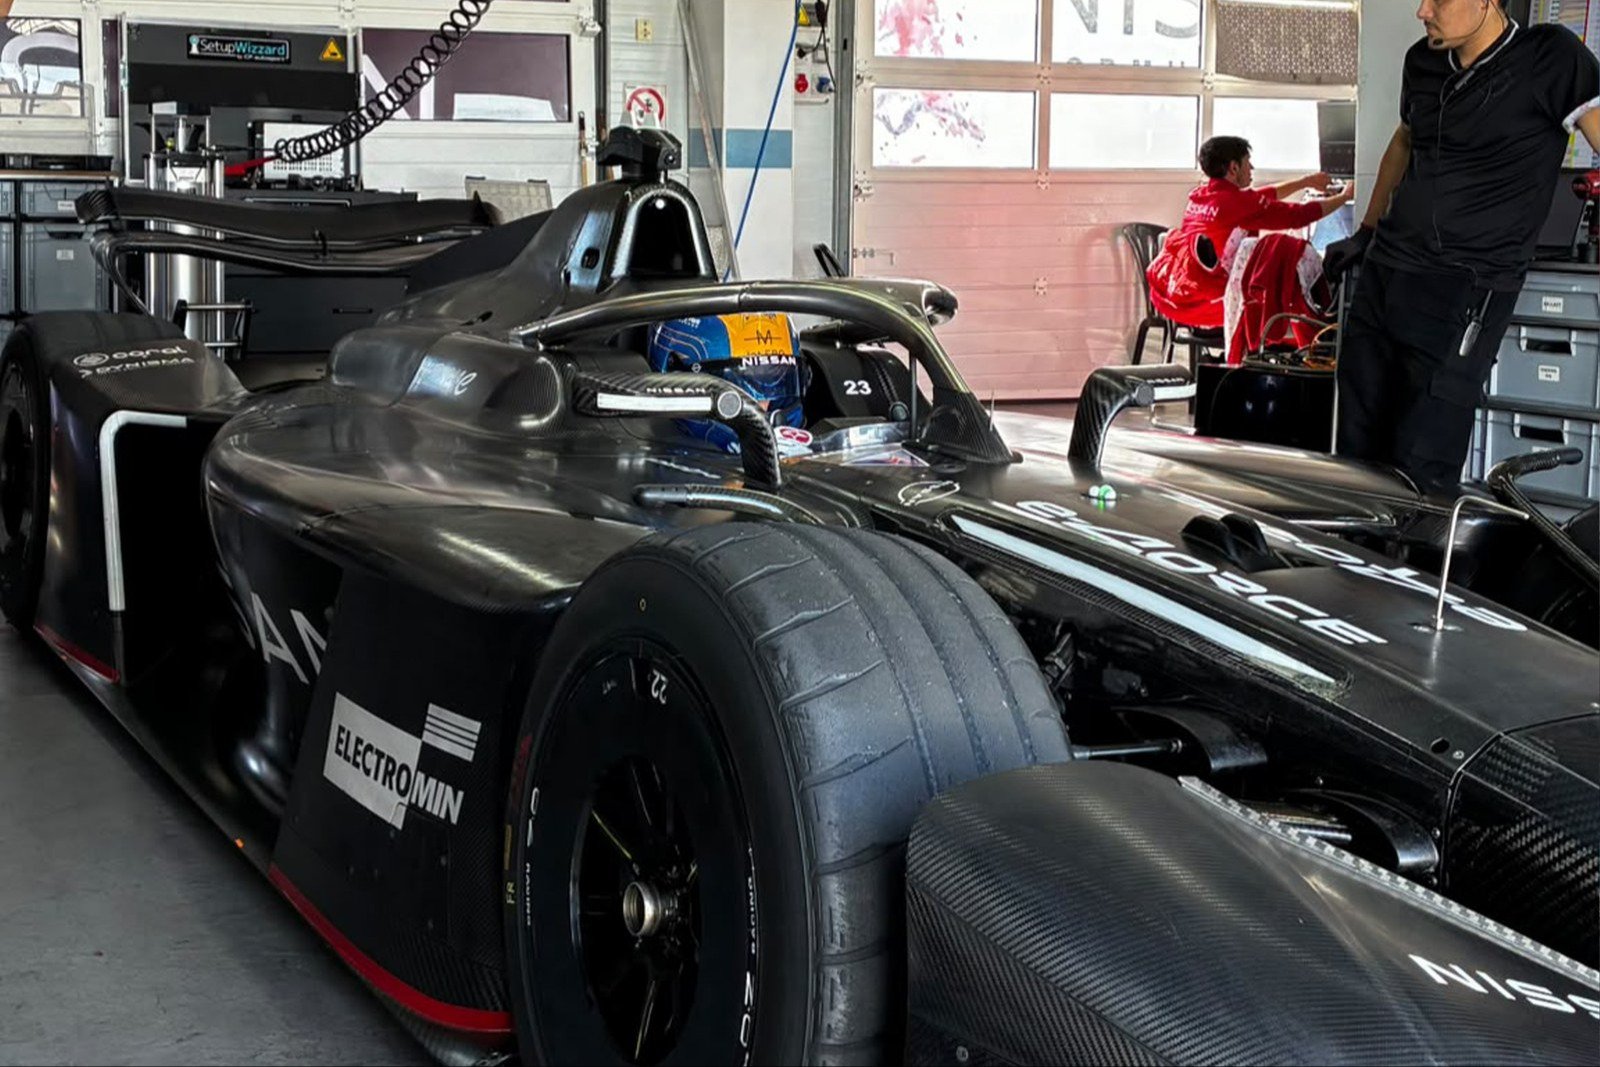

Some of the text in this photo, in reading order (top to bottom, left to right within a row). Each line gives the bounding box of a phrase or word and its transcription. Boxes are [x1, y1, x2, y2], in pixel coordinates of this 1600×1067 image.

[200, 39, 286, 56] SetupWizzard
[741, 356, 797, 366] NISSAN
[646, 386, 707, 394] NISSAN
[843, 380, 872, 395] 23
[651, 668, 668, 704] 22
[335, 724, 464, 825] ELECTROMIN
